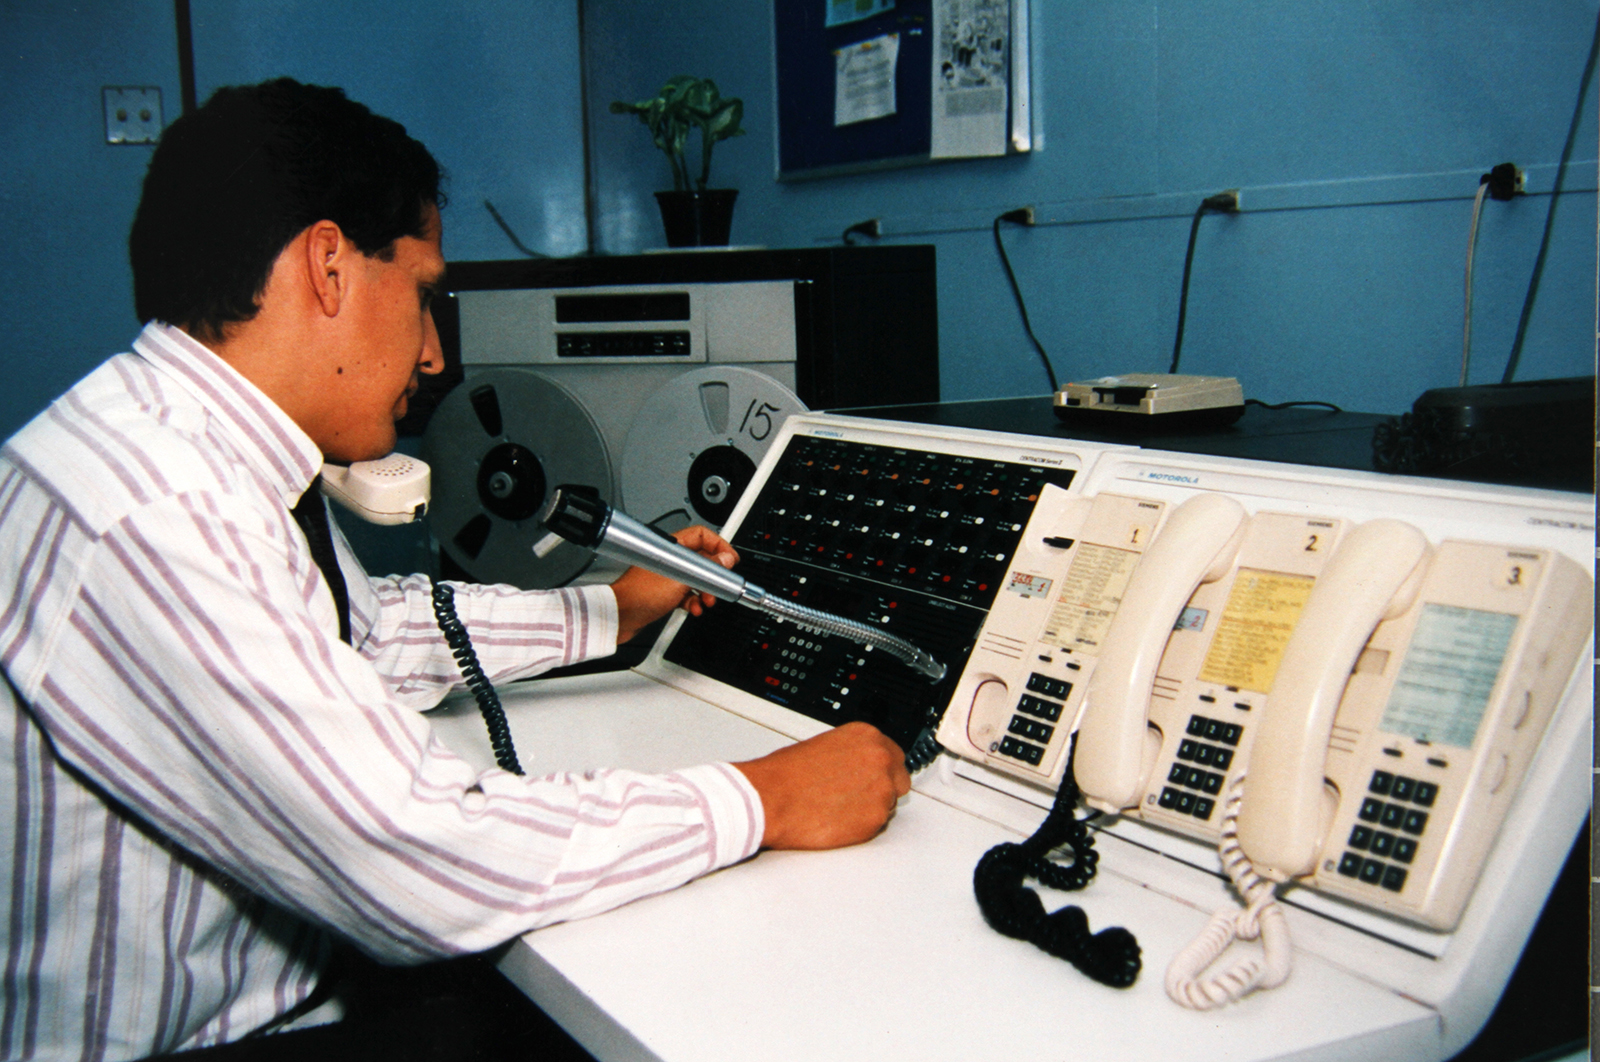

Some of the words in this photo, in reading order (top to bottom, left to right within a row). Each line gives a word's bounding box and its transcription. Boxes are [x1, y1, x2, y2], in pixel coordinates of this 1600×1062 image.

[739, 398, 781, 441] 15
[1147, 472, 1200, 484] MOTOROLA
[1131, 528, 1139, 543] 1
[1304, 534, 1318, 551] 2
[1506, 566, 1522, 585] 3
[1031, 677, 1036, 685] 1
[1044, 682, 1050, 690] 2
[1058, 686, 1065, 694] 3
[1035, 703, 1041, 711] 5
[1049, 707, 1055, 715] 6
[1026, 724, 1032, 732] 8
[1192, 721, 1198, 729] 1
[1209, 725, 1216, 734] 2
[1227, 729, 1234, 738] 3
[1182, 745, 1189, 753] 4
[1200, 749, 1207, 757] 5
[1173, 768, 1180, 777] 7
